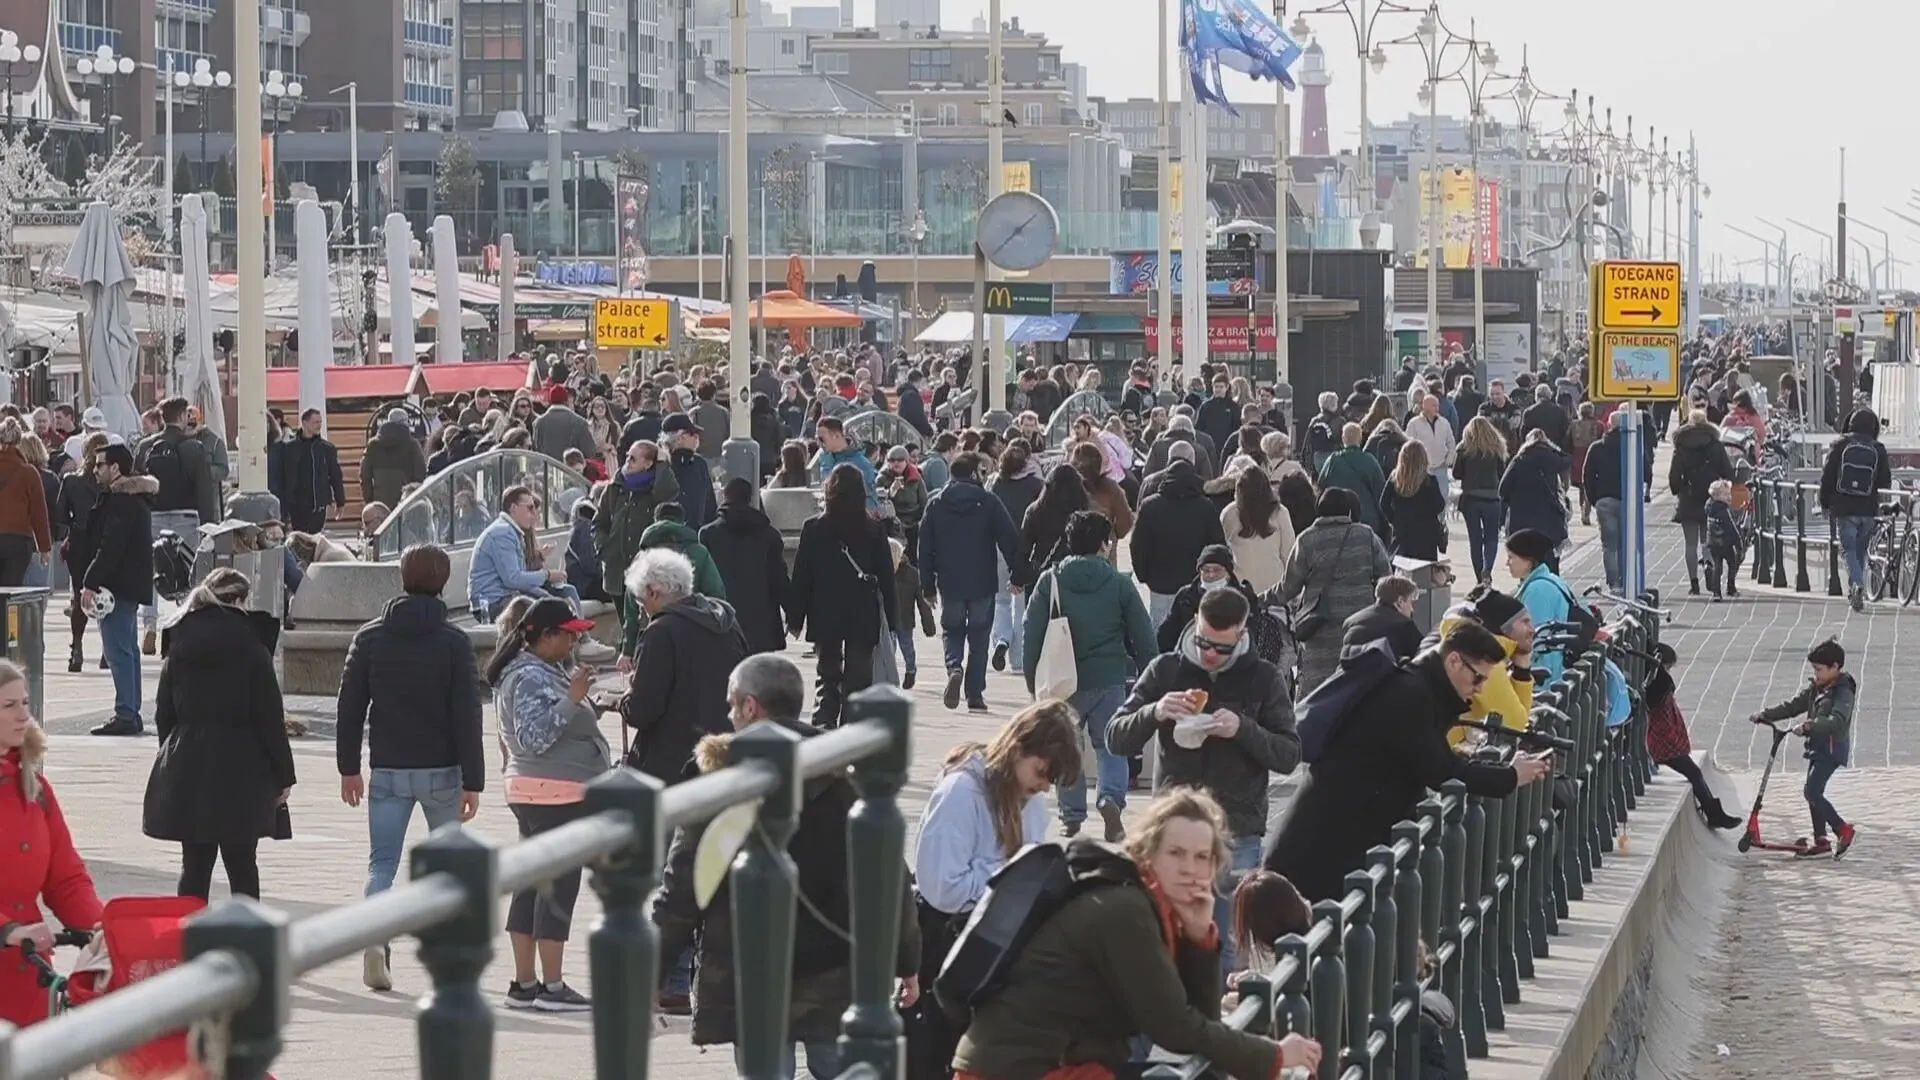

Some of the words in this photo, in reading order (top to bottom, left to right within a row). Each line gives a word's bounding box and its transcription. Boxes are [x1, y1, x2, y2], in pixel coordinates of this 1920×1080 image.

[1609, 267, 1674, 281] TOEGANG
[1613, 287, 1670, 300] STRAND
[600, 301, 650, 317] Palace
[598, 323, 645, 339] straat
[1607, 336, 1619, 346] TO
[1621, 336, 1640, 346] THE
[1642, 337, 1676, 347] BEACH
